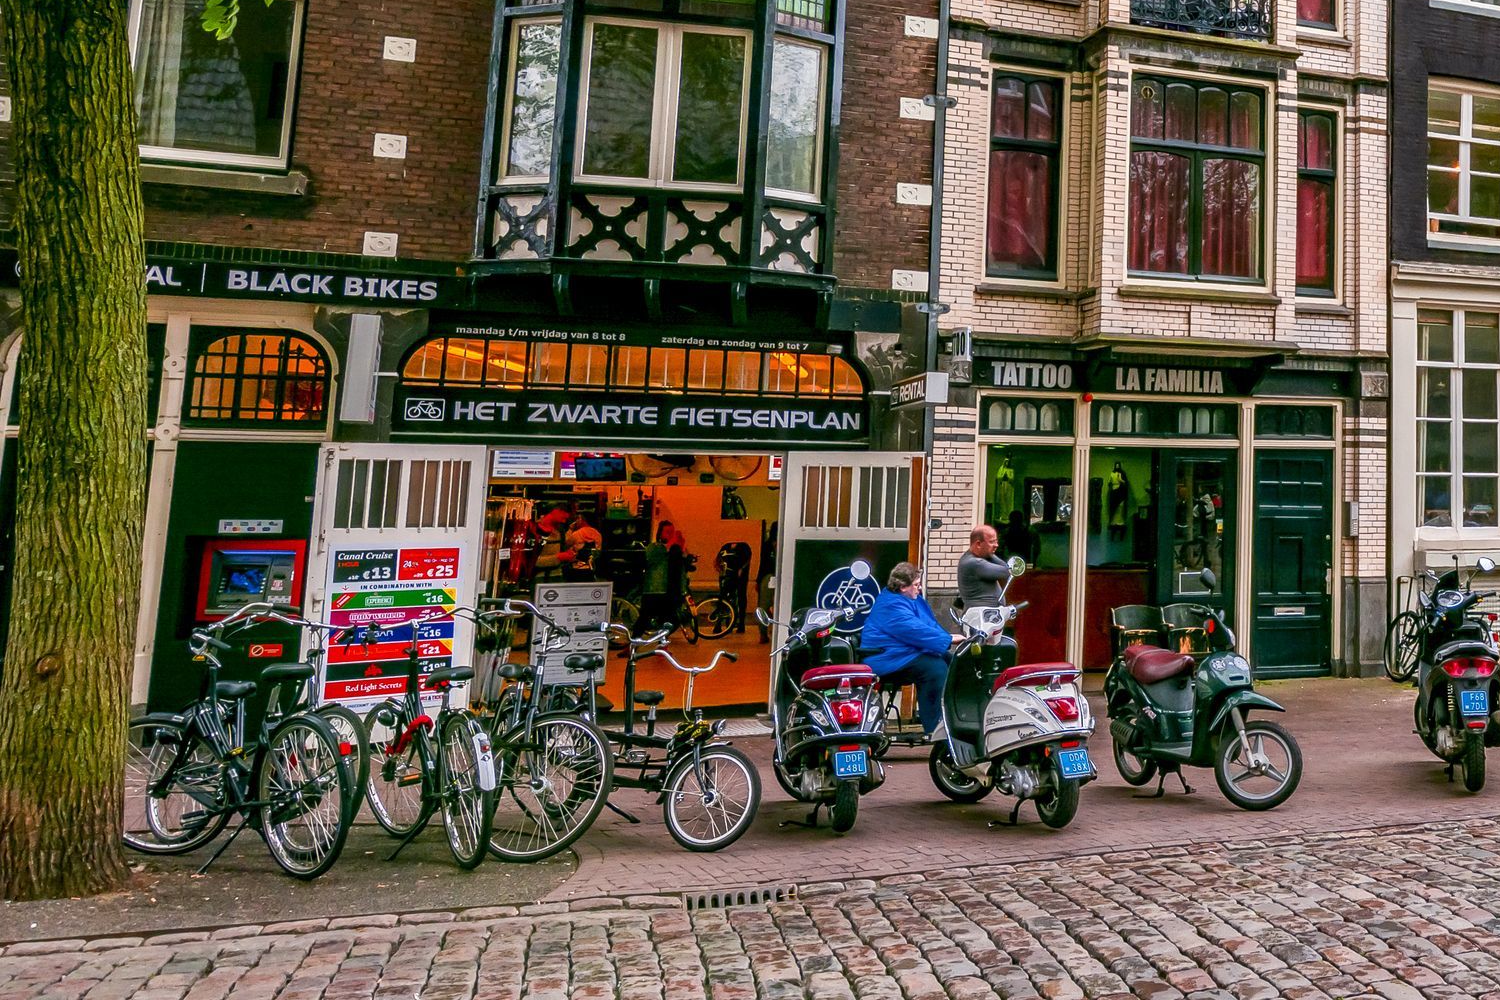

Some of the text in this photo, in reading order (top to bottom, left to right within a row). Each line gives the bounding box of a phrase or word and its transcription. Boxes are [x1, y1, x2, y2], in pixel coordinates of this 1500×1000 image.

[227, 270, 438, 300] BLACK BIKES
[456, 326, 505, 338] maandag
[508, 328, 528, 338] t/m
[531, 329, 568, 340] vrijdag
[592, 331, 599, 340] 8
[602, 332, 616, 340] tot
[619, 332, 626, 341] 8
[662, 336, 704, 348] zaterdag
[722, 338, 755, 350] zondag
[778, 340, 784, 349] 9
[786, 341, 800, 350] tot
[803, 342, 808, 350] 7
[991, 361, 1072, 388] TATTOO
[1116, 367, 1224, 394] LA FAMILIA
[900, 380, 925, 402] RENTAL
[453, 400, 860, 430] HET ZWARTE FIETSENPLAN
[338, 551, 394, 560] Canal Cruise
[363, 567, 391, 580] €13
[426, 565, 454, 577] €25
[426, 595, 443, 603] €16
[424, 628, 441, 637] €16
[423, 646, 440, 655] €21
[360, 684, 377, 693] Light
[1471, 702, 1485, 710] 7DL
[845, 753, 862, 762] DDF
[1069, 752, 1086, 761] DDK
[847, 762, 863, 772] 48L
[1072, 762, 1088, 772] 38X
